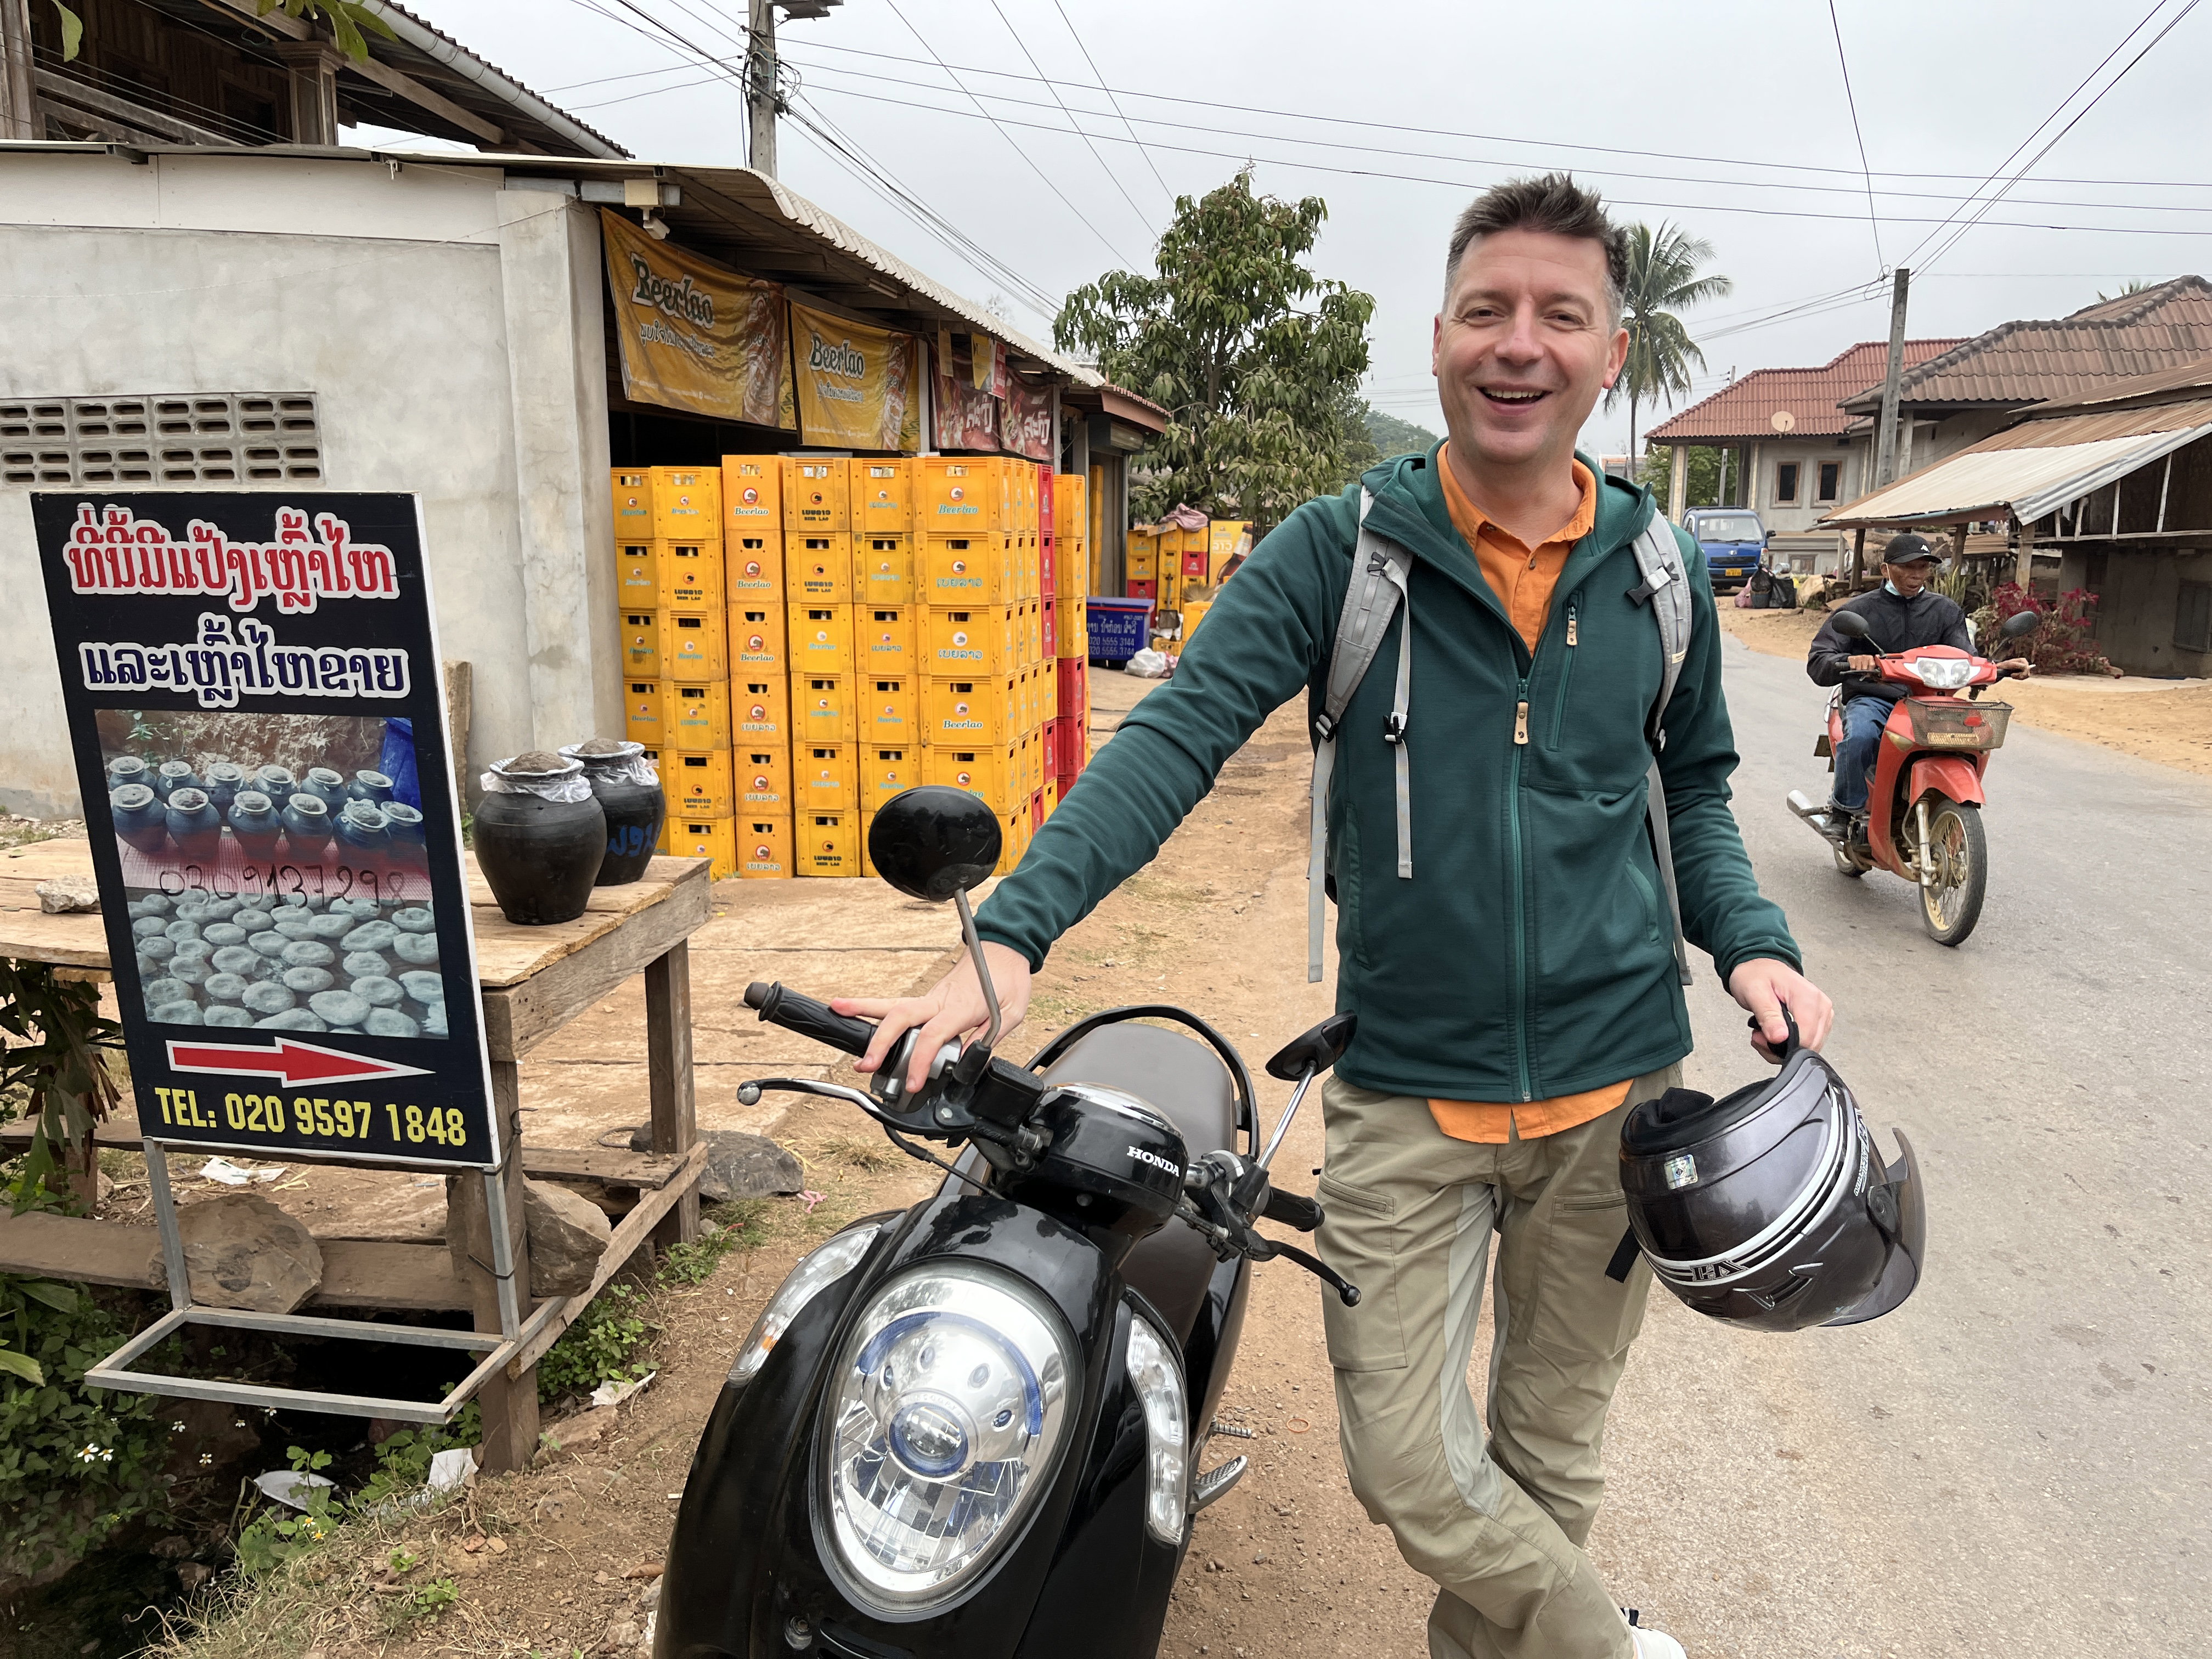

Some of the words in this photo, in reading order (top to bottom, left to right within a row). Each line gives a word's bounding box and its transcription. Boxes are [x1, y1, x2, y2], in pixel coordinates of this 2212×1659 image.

[632, 256, 713, 326] Beerlao
[809, 332, 865, 377] Beerlao
[938, 504, 979, 515] Beerlao
[737, 579, 771, 588] Beerlao
[937, 578, 983, 588] ເບຍລາວ
[82, 616, 407, 703] ແລະເຫຼົ້າໄຫຂາຍ
[740, 653, 775, 662] Beerlao
[938, 649, 983, 660] ເບຍລາວ
[943, 720, 983, 729] Beerlao
[746, 863, 781, 871] ເບຍລາວ
[155, 1087, 217, 1128] TEL:
[225, 1093, 285, 1133] 020
[294, 1097, 371, 1139] 9597
[386, 1104, 466, 1147] 1848
[1127, 1146, 1180, 1178] HONDA
